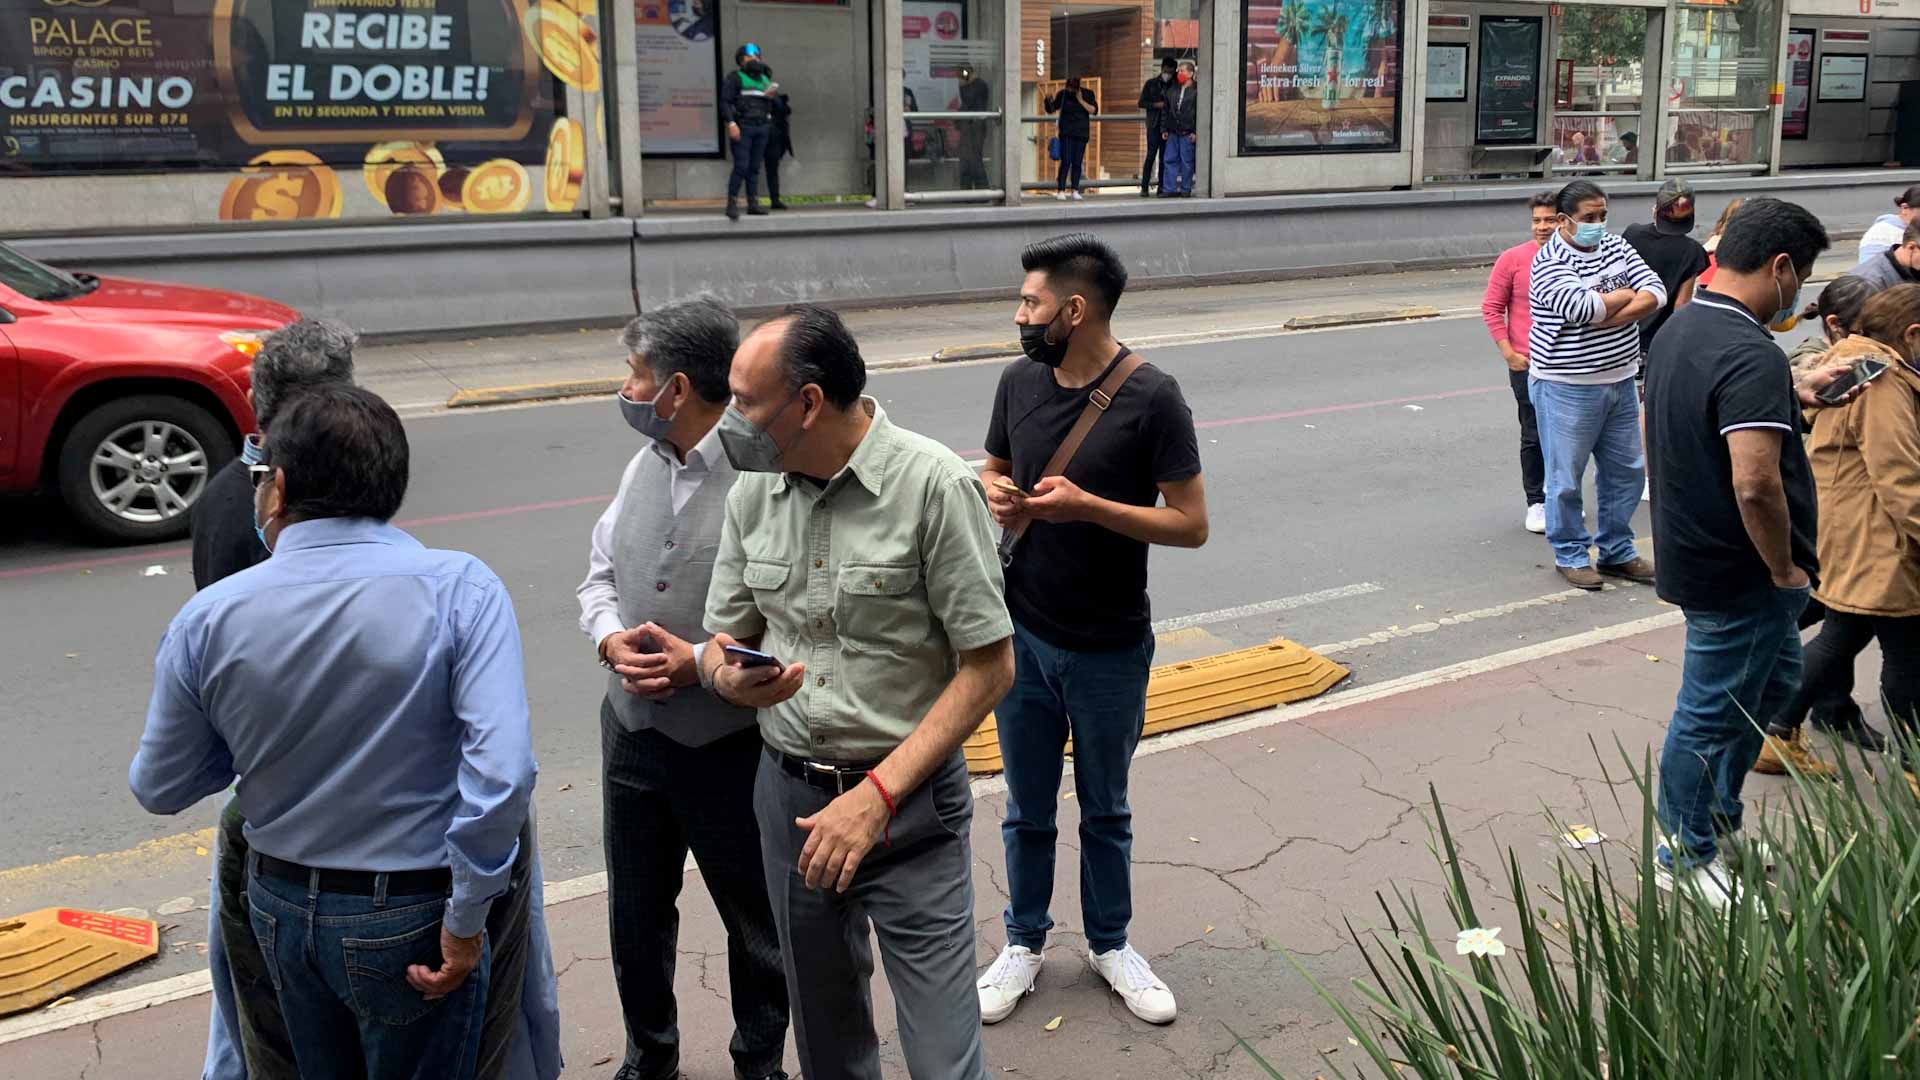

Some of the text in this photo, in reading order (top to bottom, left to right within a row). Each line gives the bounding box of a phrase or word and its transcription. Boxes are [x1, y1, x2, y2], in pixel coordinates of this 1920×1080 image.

[30, 17, 153, 46] PALACE
[301, 12, 453, 49] RECIBE
[33, 47, 154, 57] BINGO & SPORT BETS
[1036, 39, 1044, 76] 383
[73, 59, 120, 69] CASINO
[1261, 64, 1321, 73] Heineken Silver
[266, 64, 489, 101] EL DOBLE!
[1260, 74, 1385, 88] Extra fresh for real
[0, 76, 193, 108] CASINO
[274, 106, 485, 117] EN TU SEGUNDA Y TERCERA VISITA
[10, 114, 188, 126] INSURGENTES SUR 878
